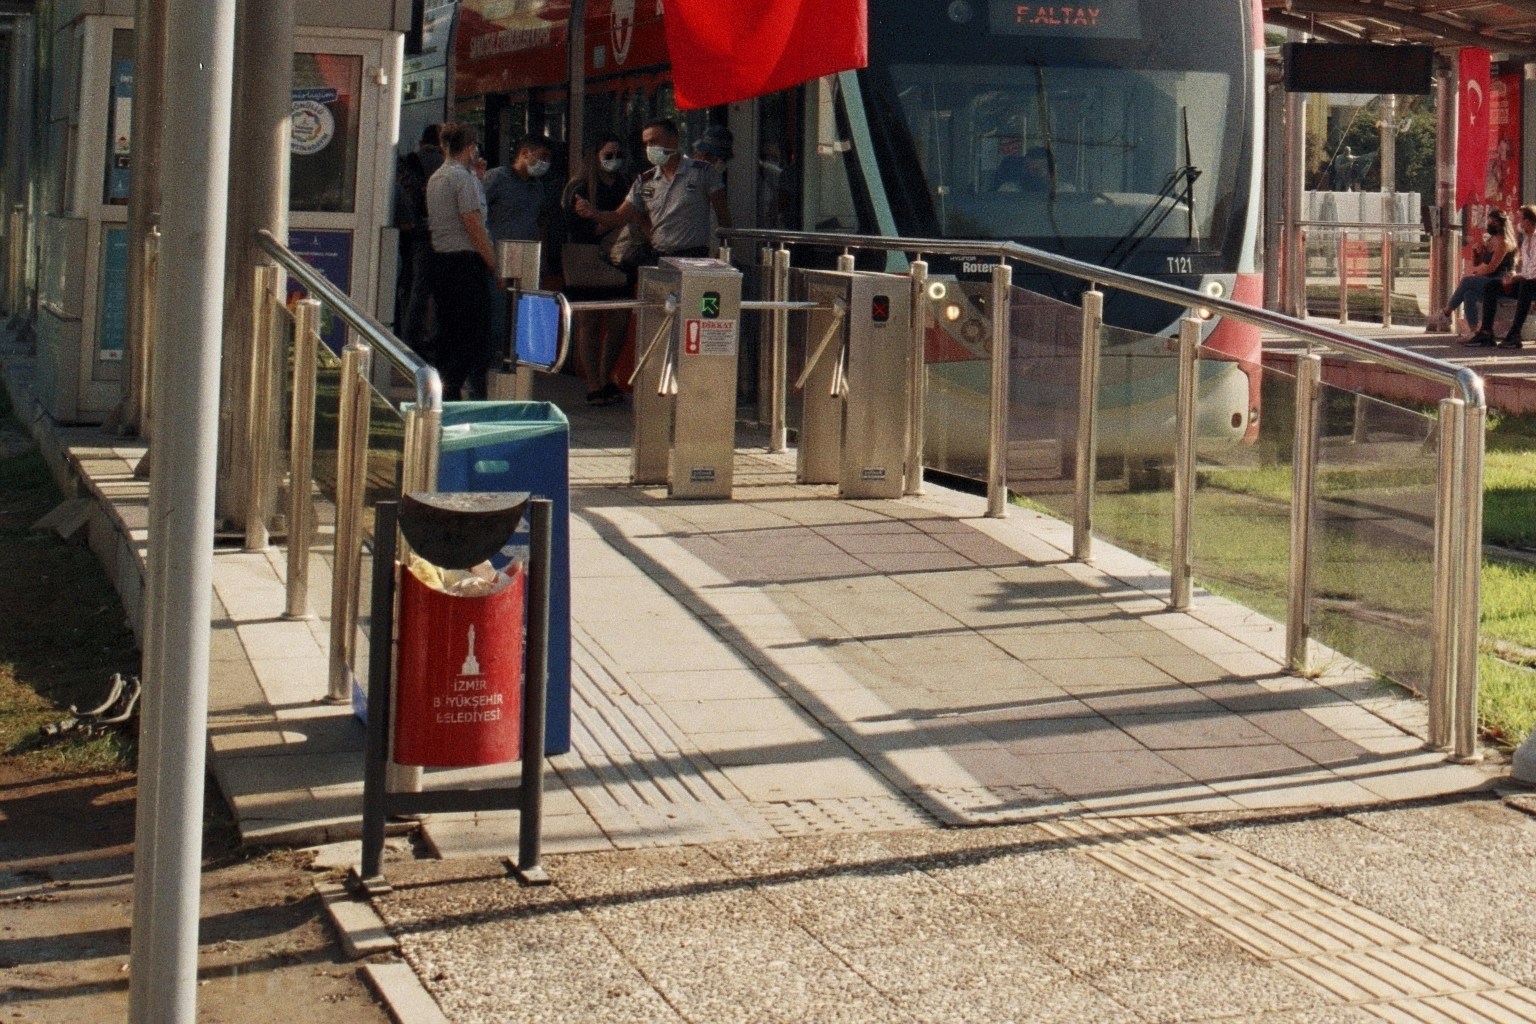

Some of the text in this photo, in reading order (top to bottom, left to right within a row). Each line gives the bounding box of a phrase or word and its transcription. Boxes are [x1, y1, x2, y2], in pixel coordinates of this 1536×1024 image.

[1016, 5, 1101, 26] F.ALTAY
[1167, 256, 1193, 274] T121
[453, 679, 487, 692] İZMİR
